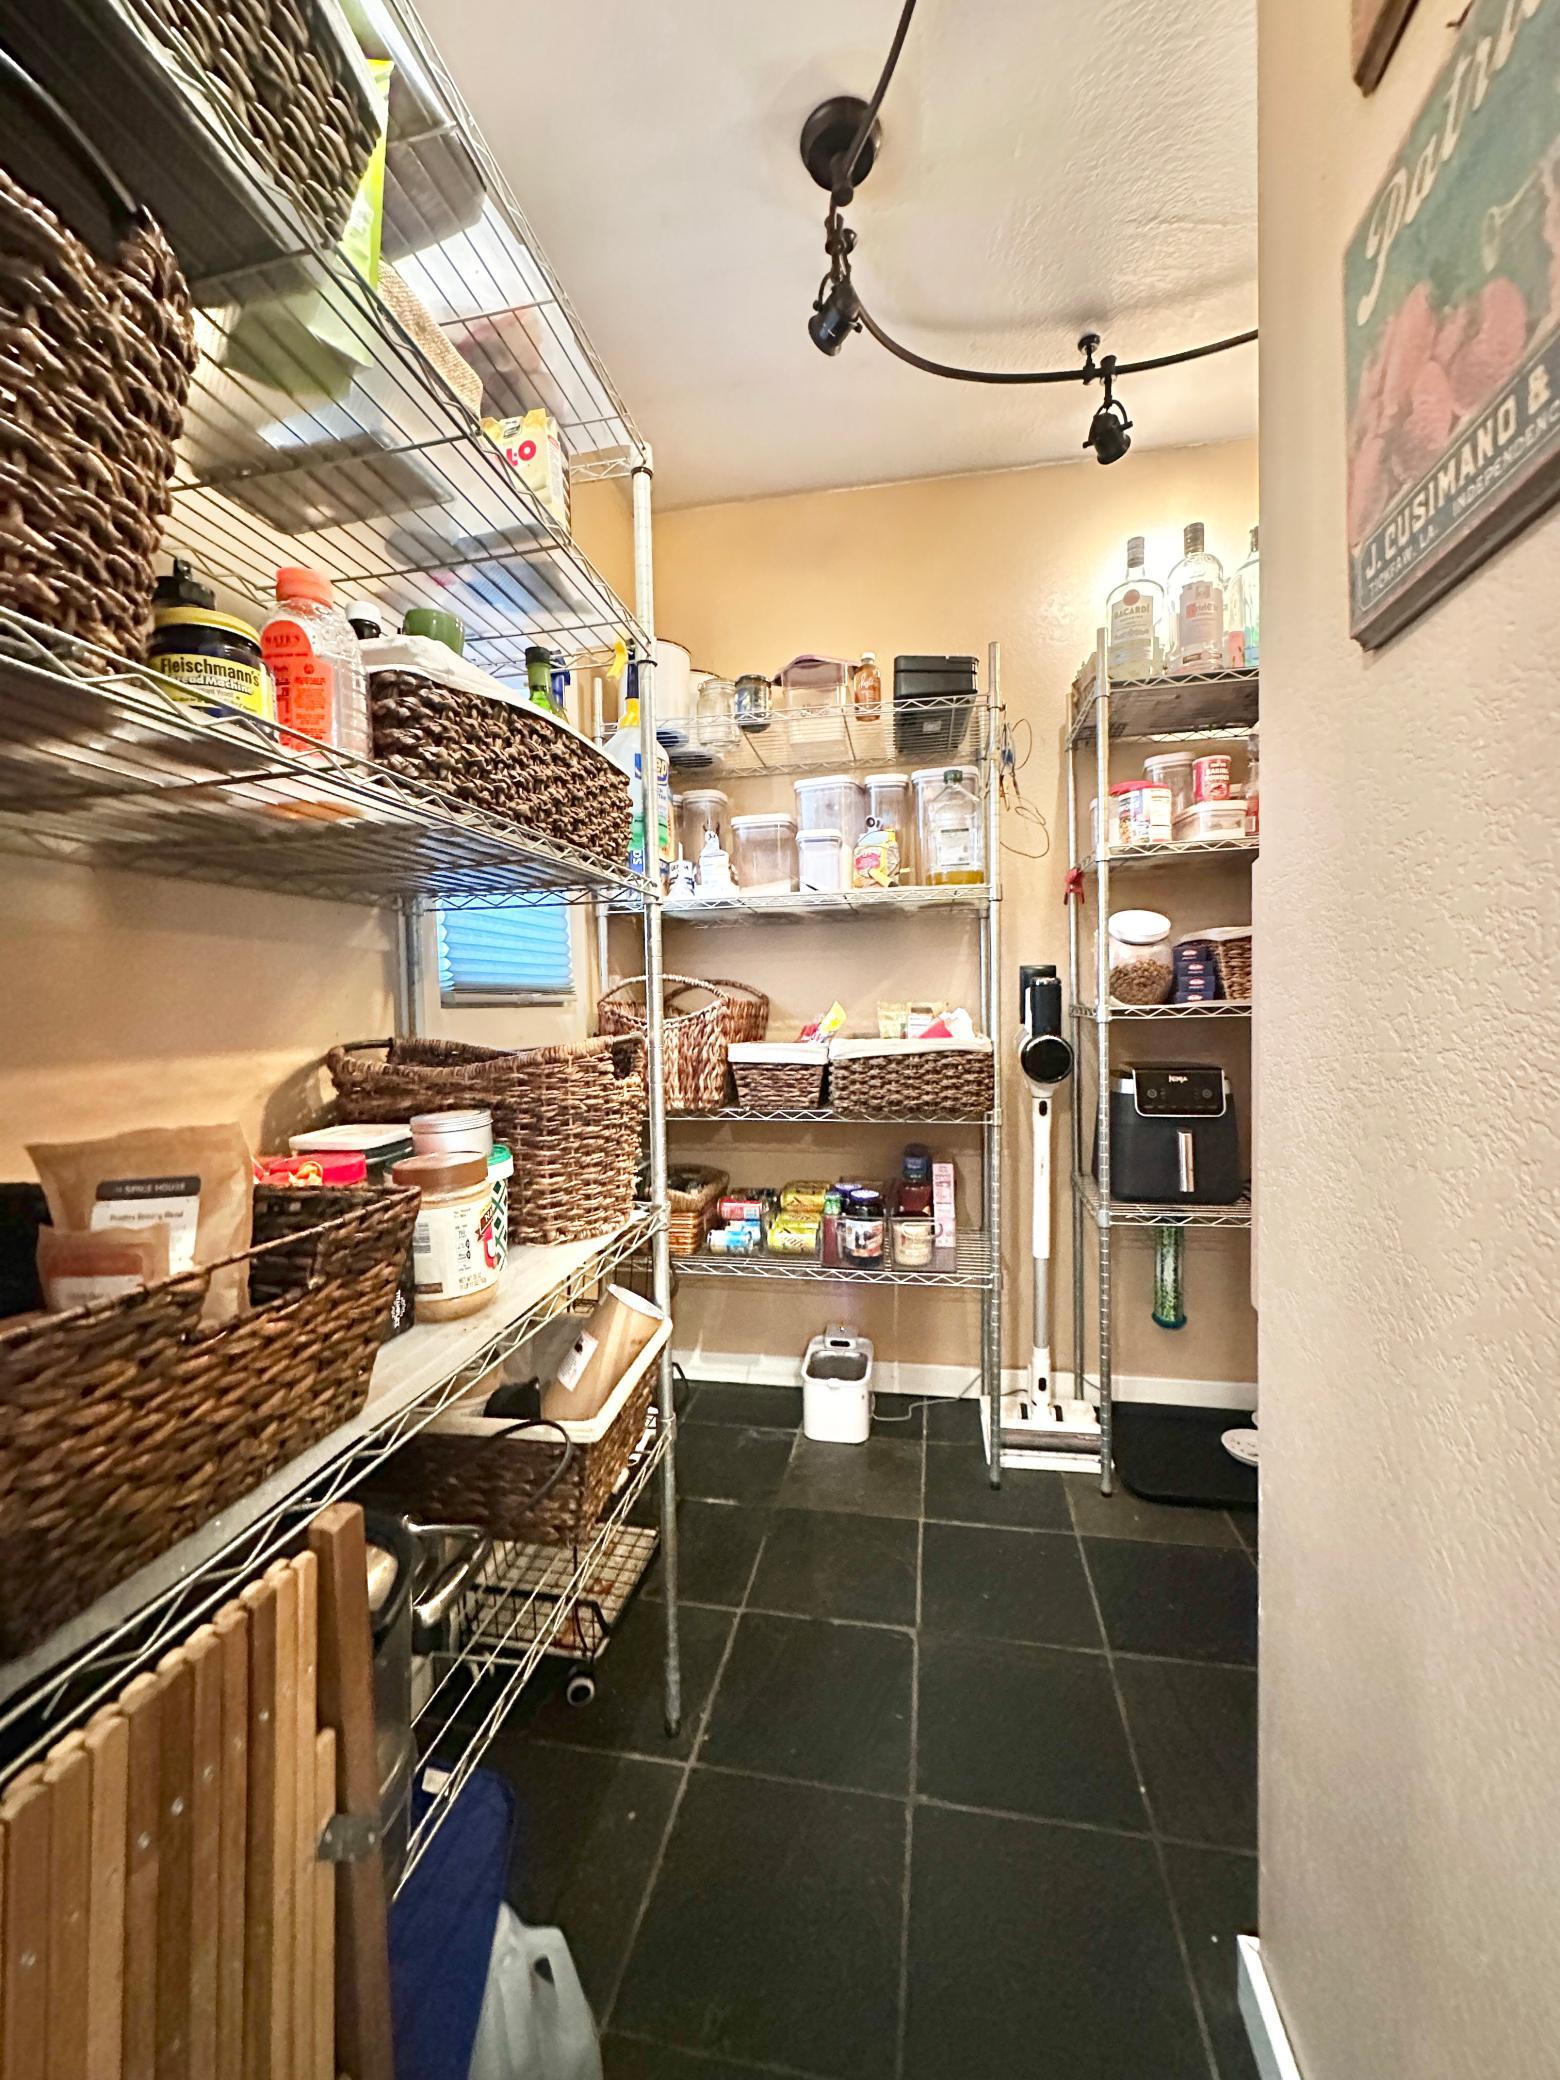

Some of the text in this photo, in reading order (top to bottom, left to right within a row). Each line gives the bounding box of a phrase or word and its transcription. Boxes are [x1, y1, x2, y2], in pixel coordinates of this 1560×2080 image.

[1365, 364, 1552, 580] J. CUSIMANO &
[160, 657, 260, 688] Fleischmann's
